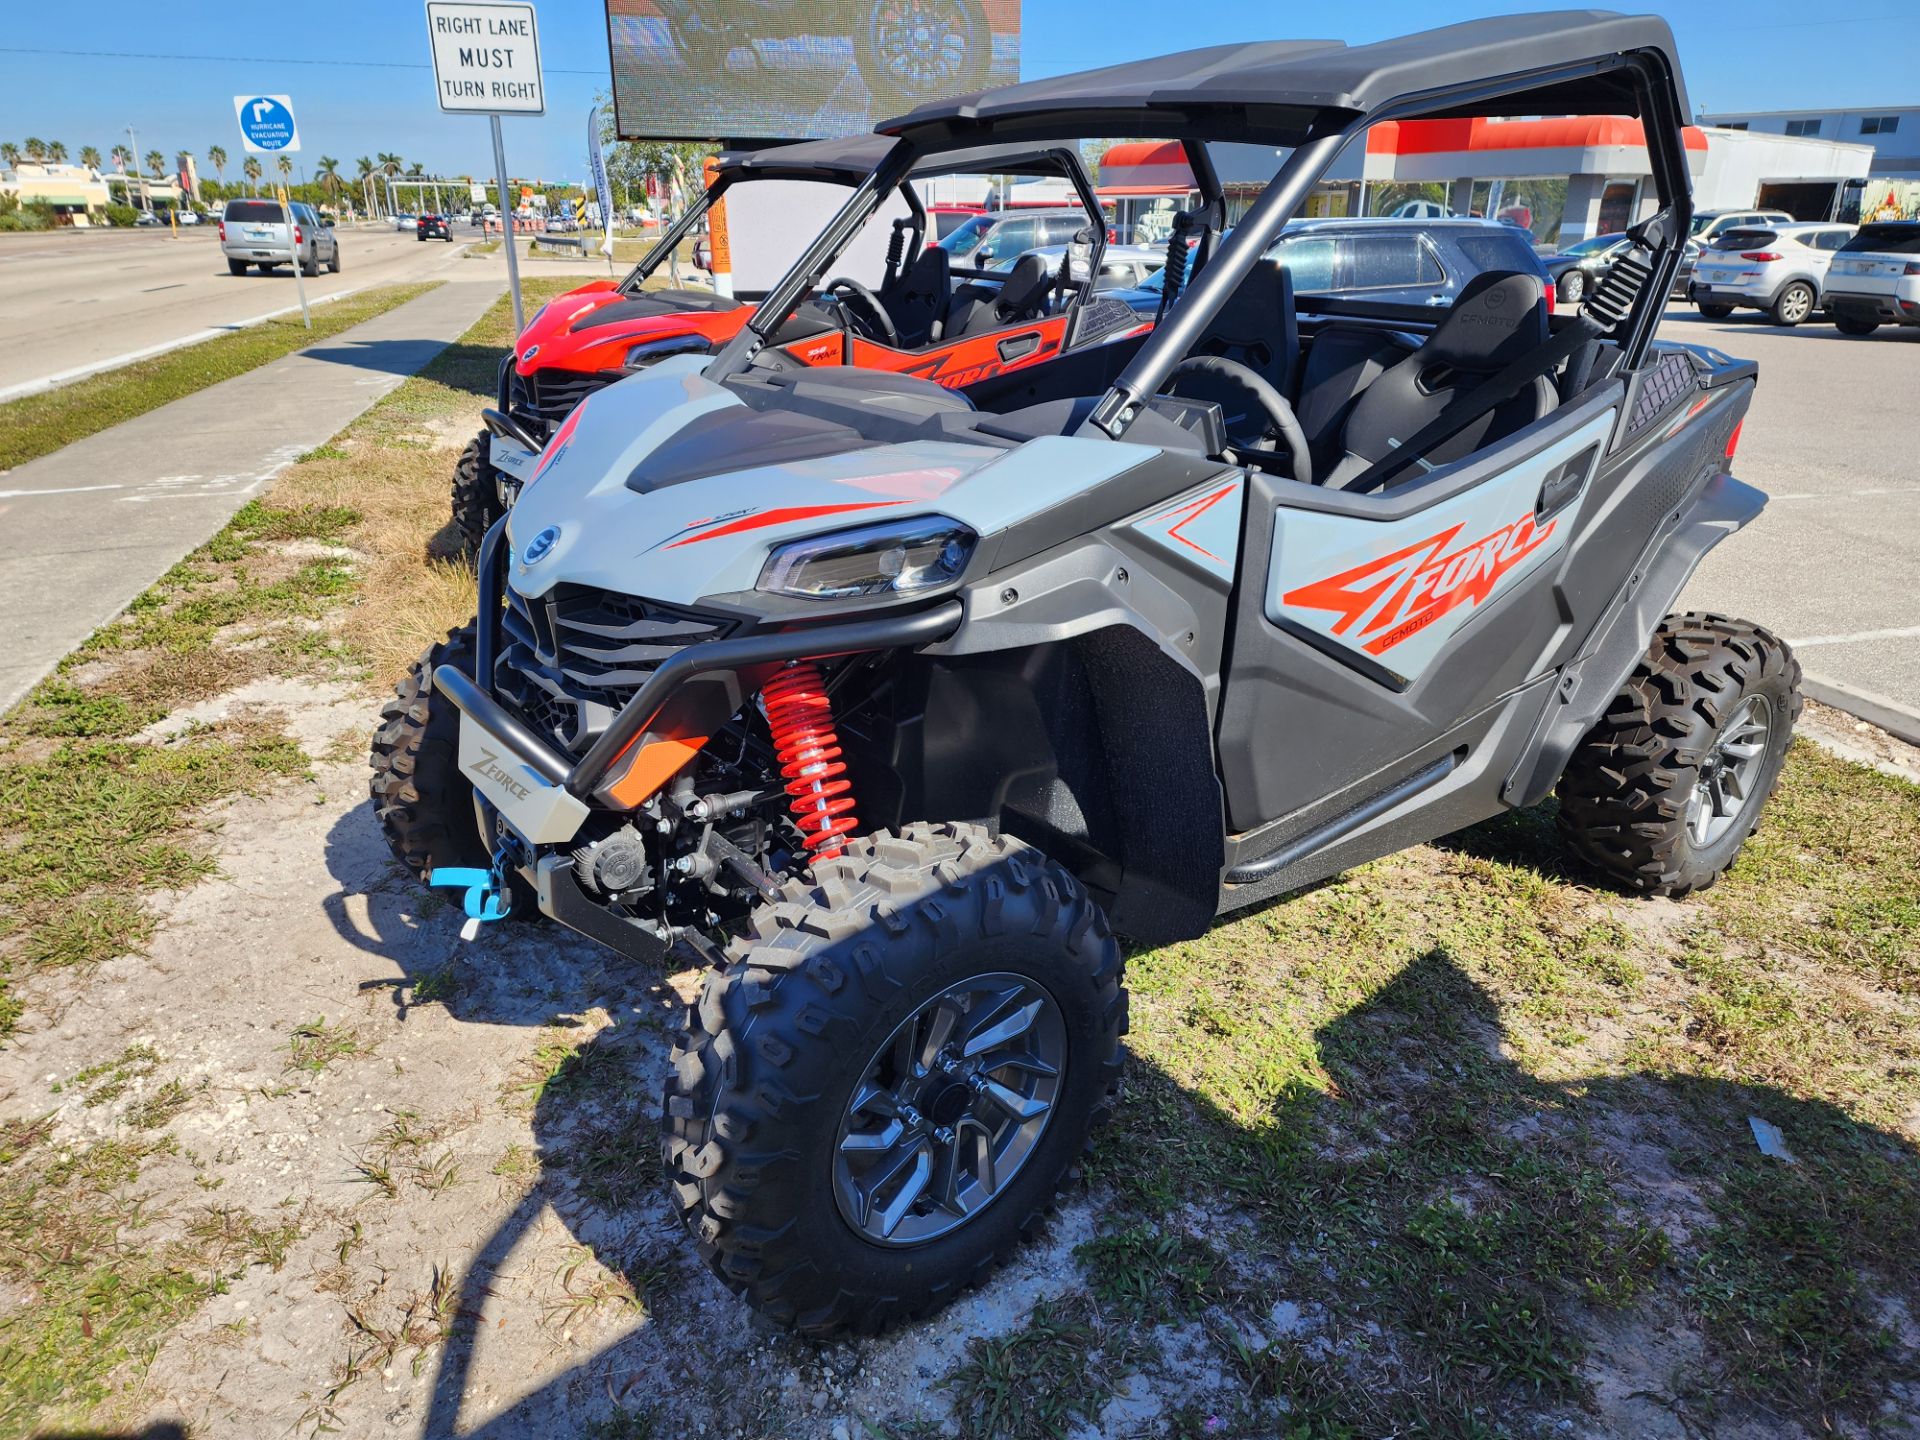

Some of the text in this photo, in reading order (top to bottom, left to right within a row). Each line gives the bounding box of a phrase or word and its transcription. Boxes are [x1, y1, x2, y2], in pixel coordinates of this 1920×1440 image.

[436, 16, 529, 36] RIGHT LANE
[459, 47, 514, 68] MUST
[443, 80, 536, 98] TURN RIGHT
[250, 122, 285, 131] HURRICANE
[250, 131, 290, 139] EVACUATION
[262, 139, 282, 147] ROUTE
[1382, 610, 1434, 648] CFMOTO
